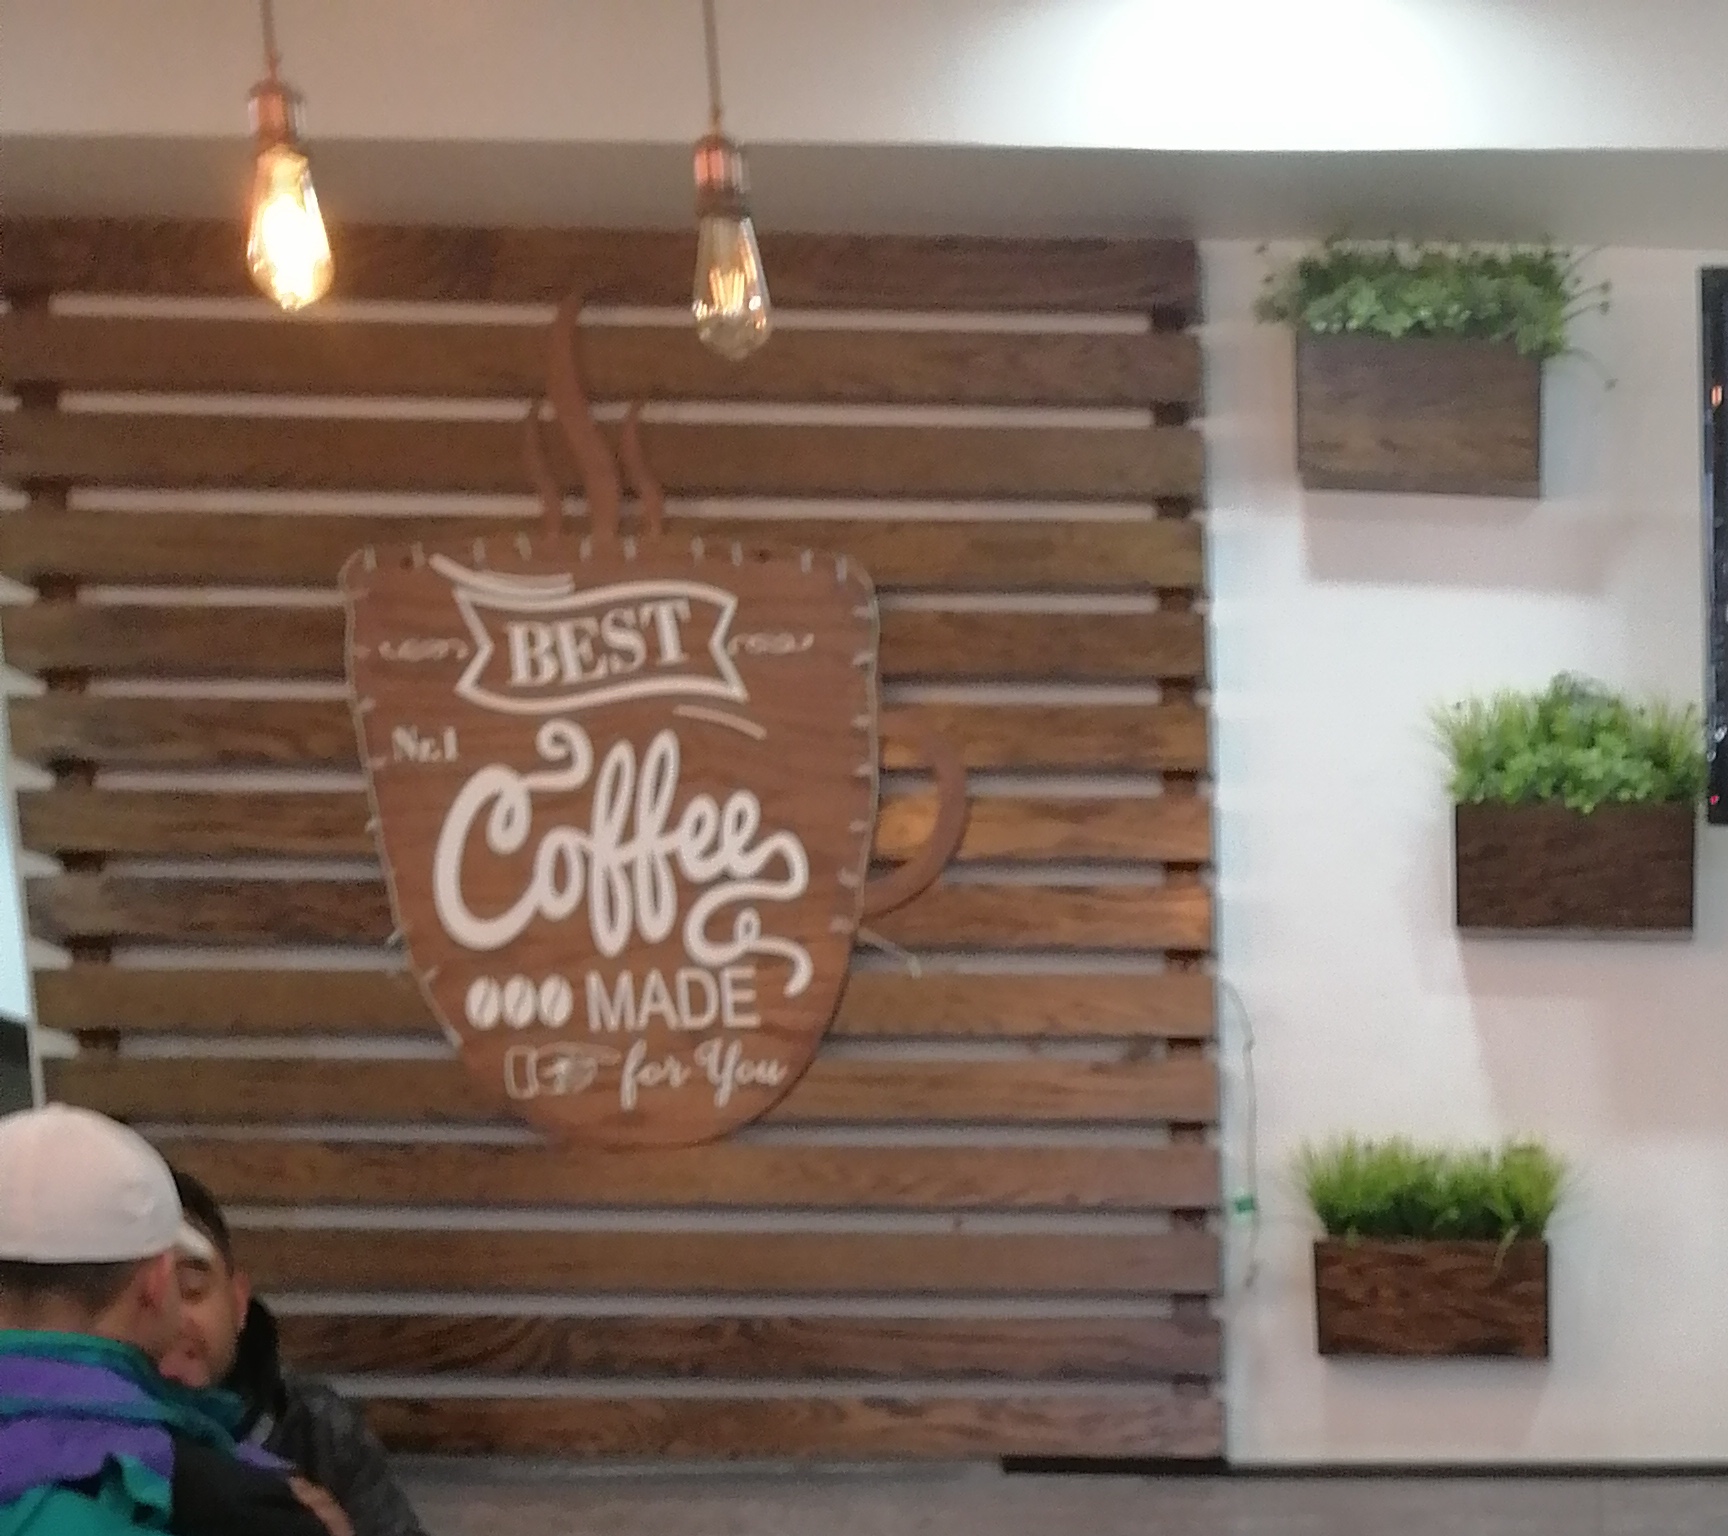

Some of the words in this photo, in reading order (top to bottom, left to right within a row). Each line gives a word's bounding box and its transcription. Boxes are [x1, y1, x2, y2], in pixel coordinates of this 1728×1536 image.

[508, 600, 692, 687] BEST
[434, 721, 812, 997] Coffee
[586, 971, 762, 1032] MADE
[620, 1039, 691, 1111] for
[694, 1037, 788, 1108] You
